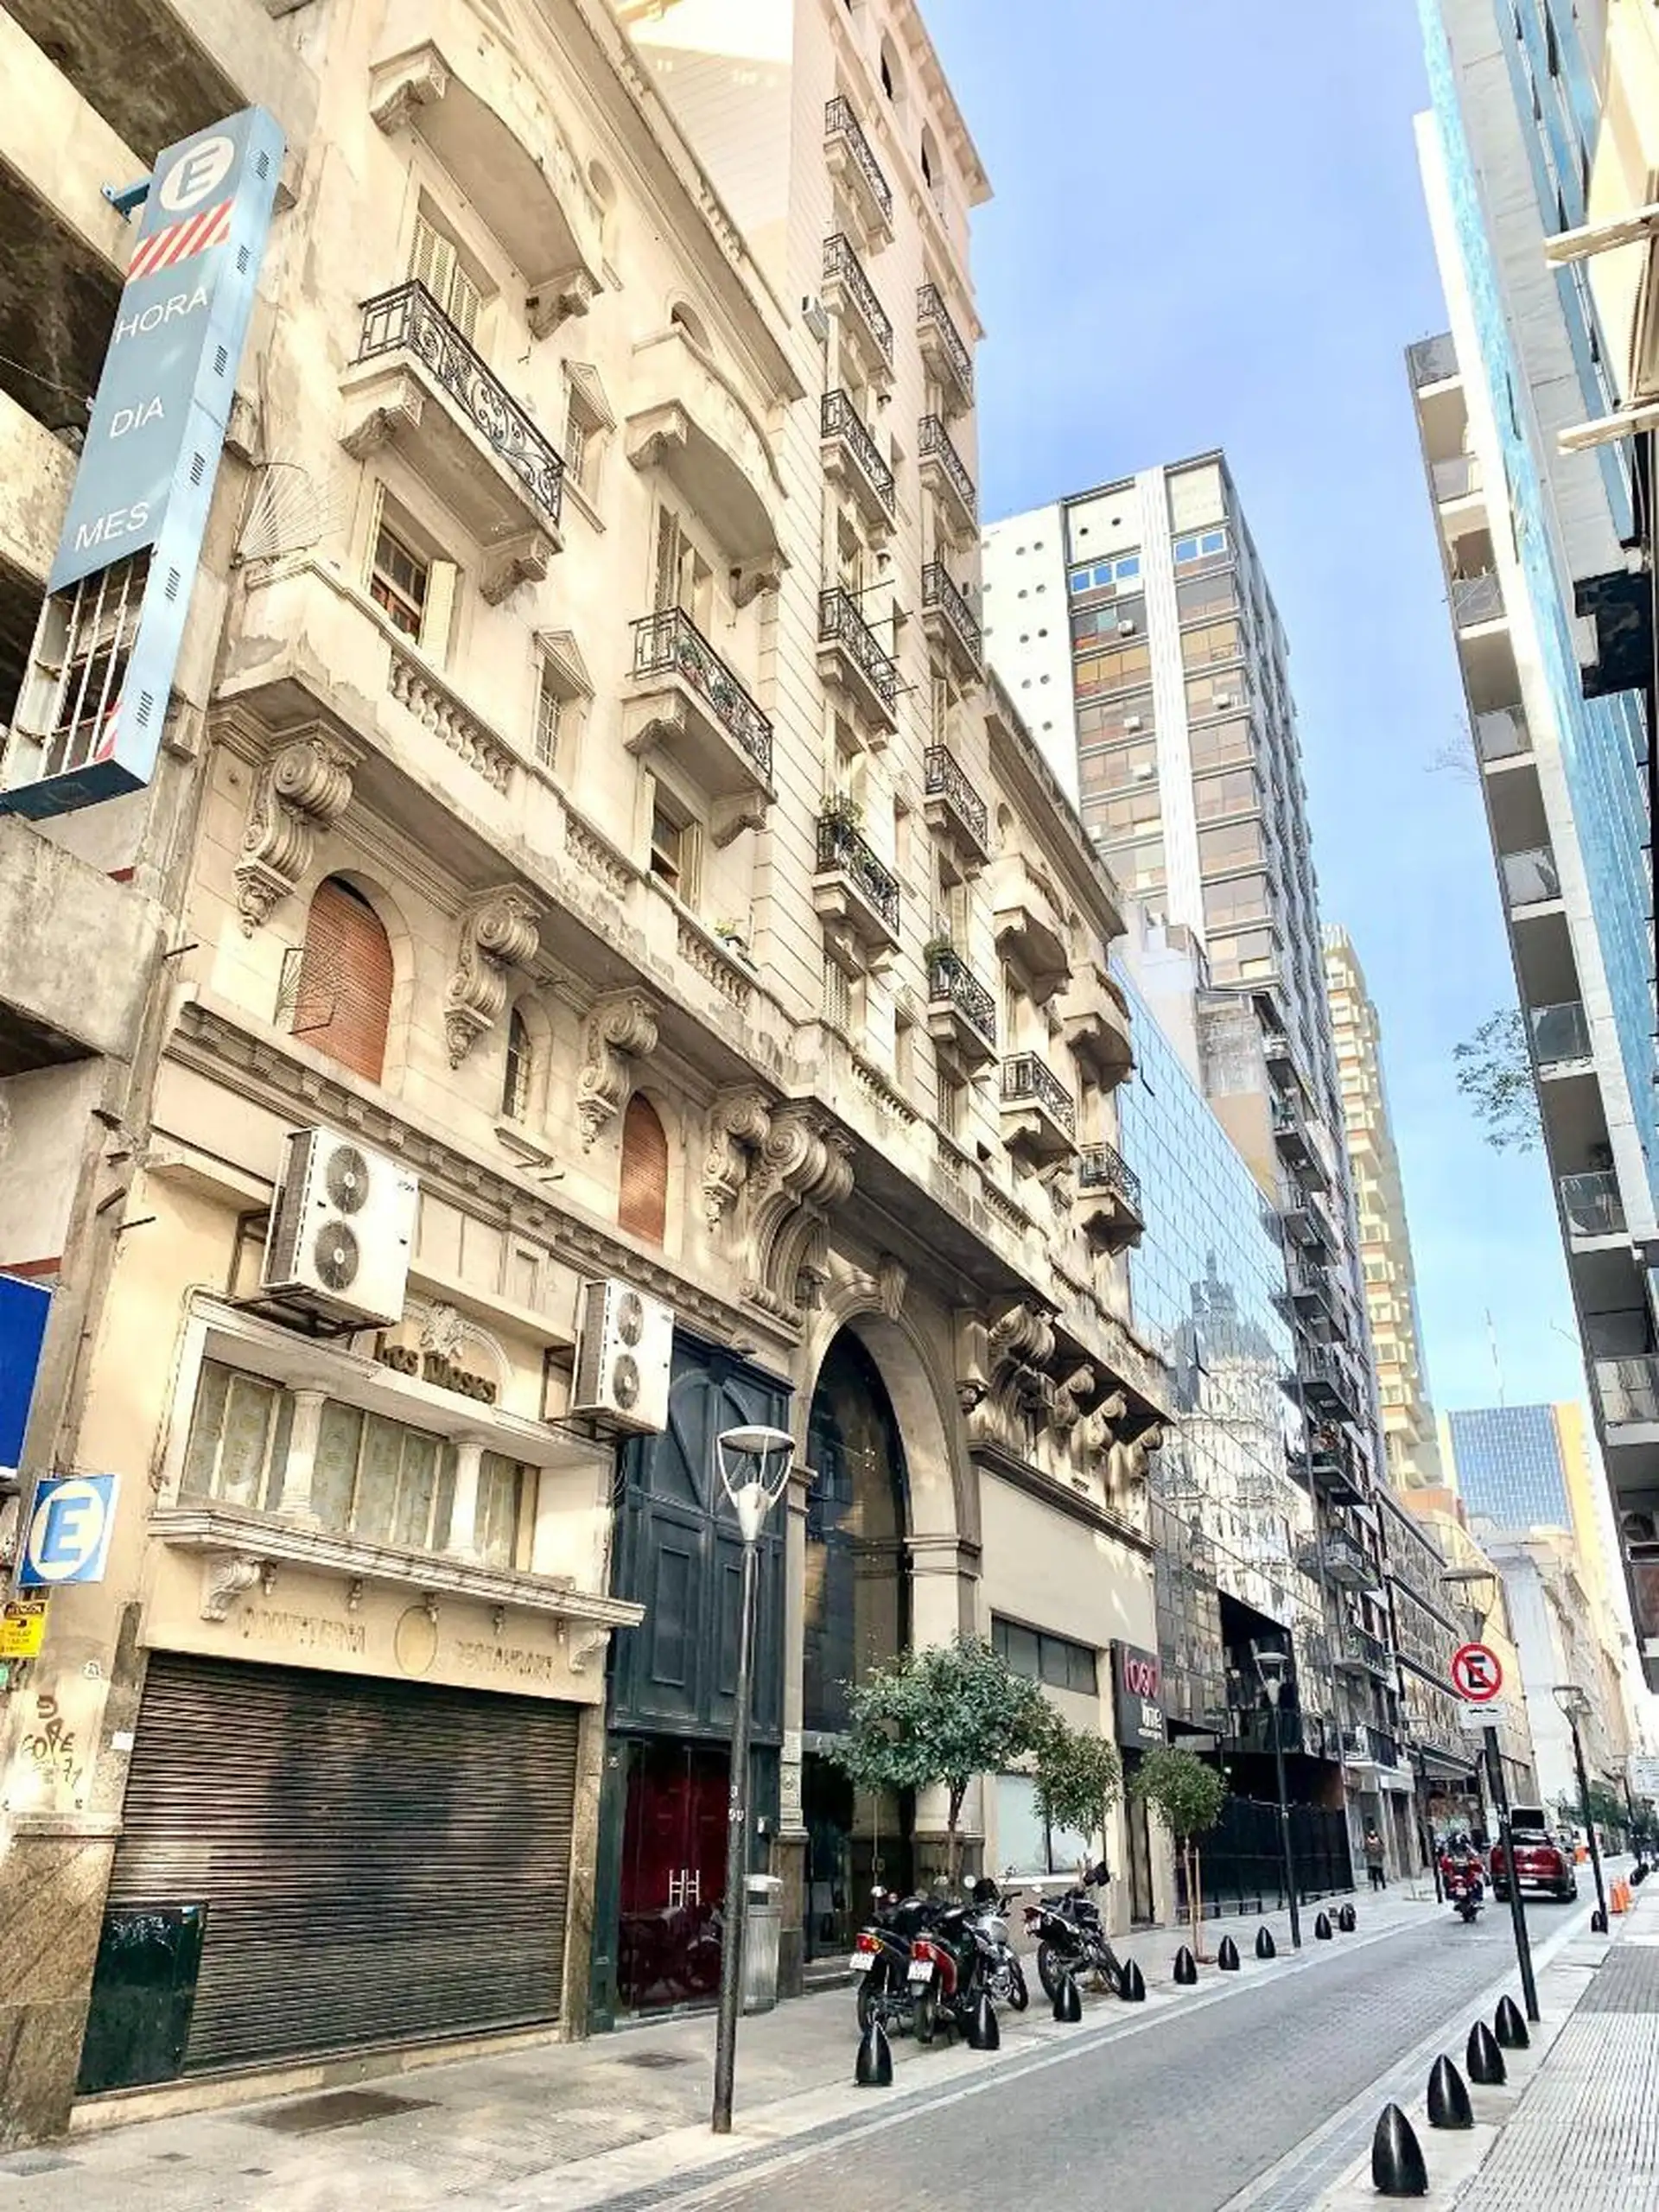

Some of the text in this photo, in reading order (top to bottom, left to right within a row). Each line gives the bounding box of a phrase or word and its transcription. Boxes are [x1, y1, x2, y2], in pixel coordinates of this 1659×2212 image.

[175, 143, 220, 201] E
[115, 286, 208, 345] HORA
[110, 395, 165, 439] DIA
[74, 502, 150, 553] MES
[40, 1497, 92, 1564] E
[1466, 1656, 1490, 1688] E
